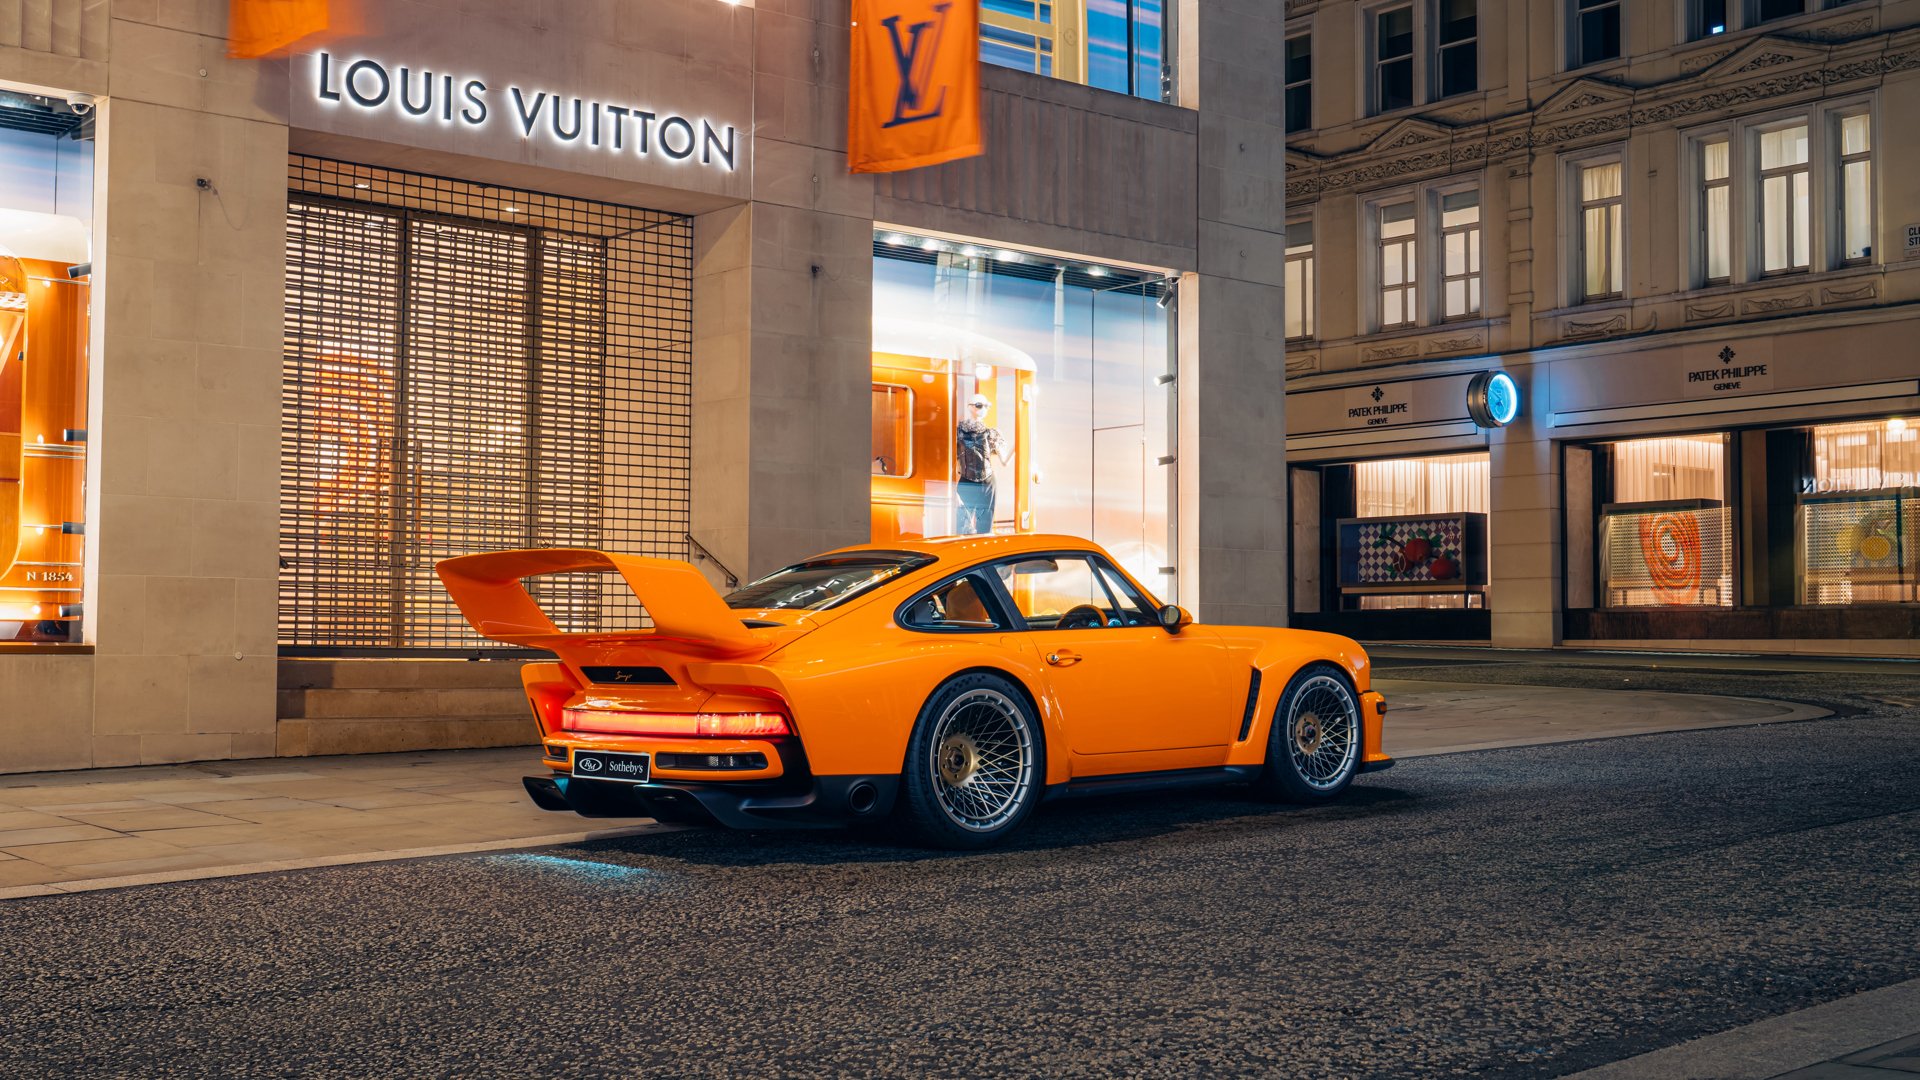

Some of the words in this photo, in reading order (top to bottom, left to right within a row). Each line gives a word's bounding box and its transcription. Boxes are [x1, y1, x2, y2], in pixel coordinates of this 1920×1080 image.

[319, 52, 487, 125] LOUIS
[511, 87, 734, 171] VUITTON
[1688, 369, 1720, 383] PATEK
[1721, 364, 1767, 379] PHILIPPE
[1713, 381, 1742, 391] GENEVE
[1348, 406, 1373, 418] PATEK
[1373, 402, 1408, 415] PHILIPPE
[1367, 417, 1389, 425] GENEVE
[26, 571, 37, 582] N
[41, 571, 73, 582] 1854
[609, 761, 643, 776] Sotheby's
